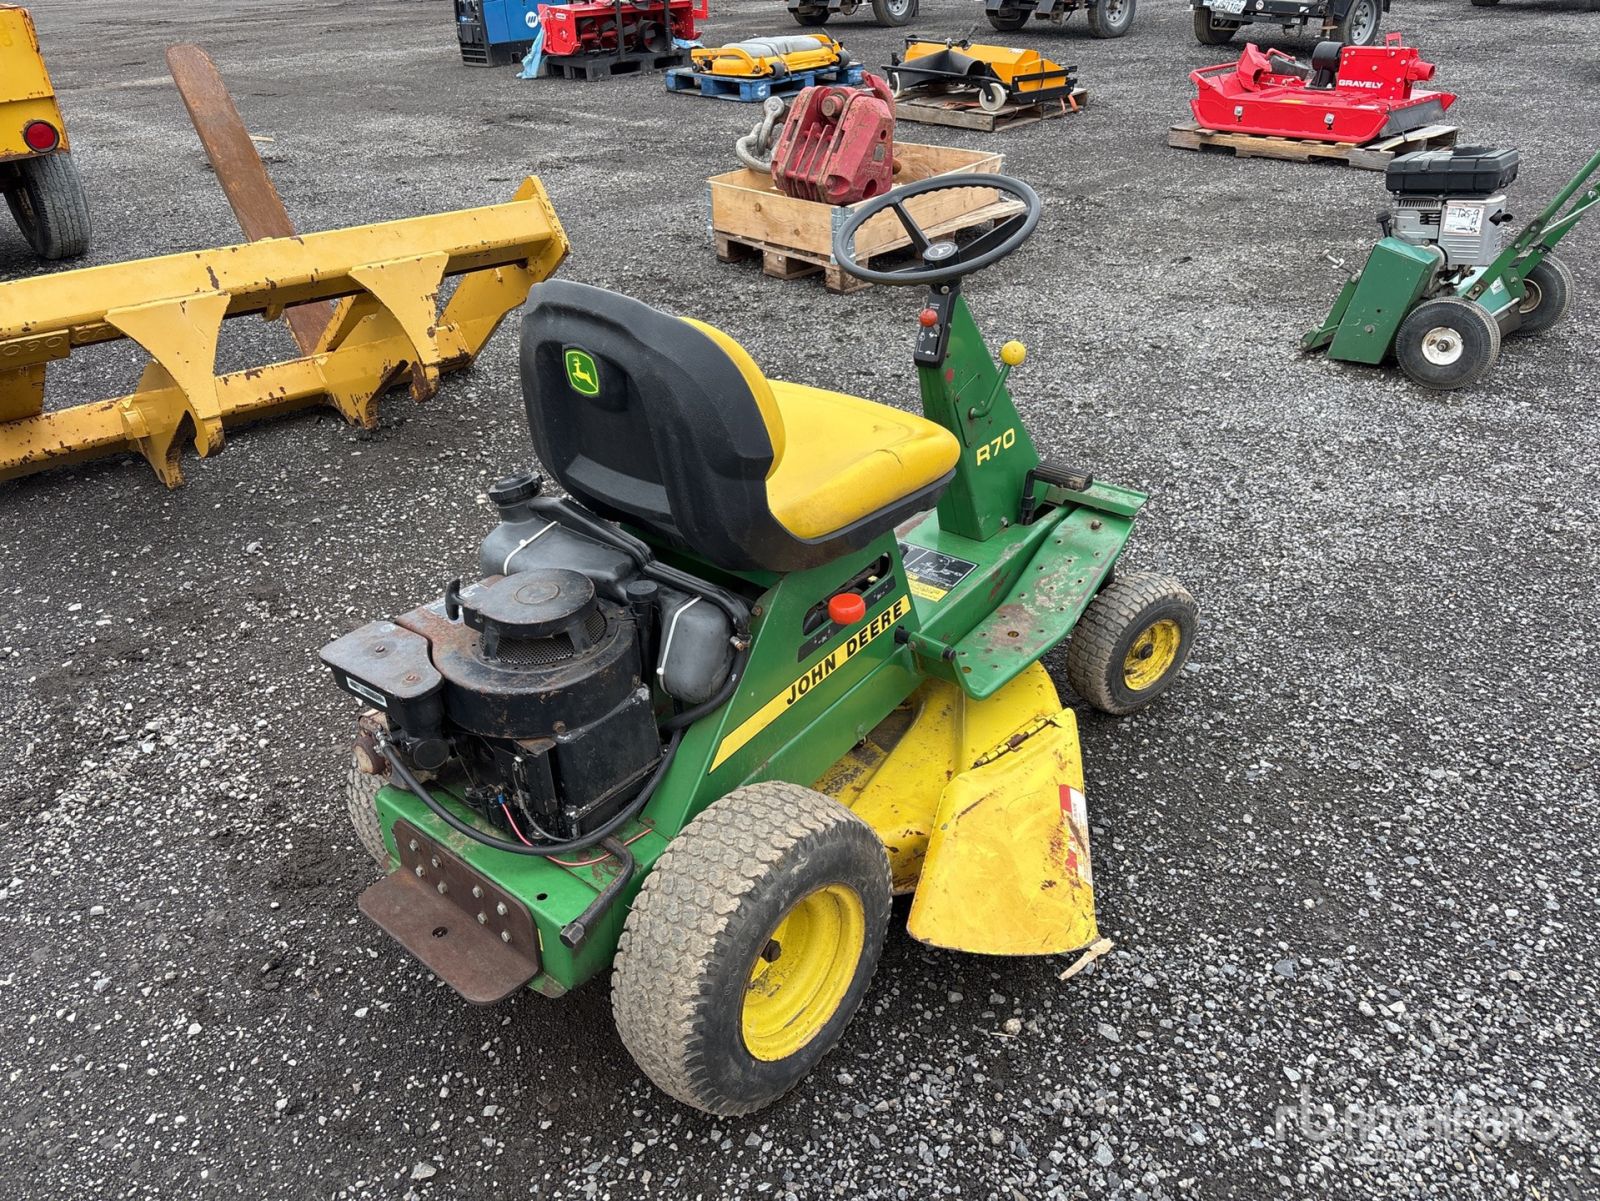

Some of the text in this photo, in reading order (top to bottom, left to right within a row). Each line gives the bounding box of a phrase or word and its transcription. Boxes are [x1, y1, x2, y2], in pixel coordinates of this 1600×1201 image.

[1338, 79, 1383, 89] GRAVELY
[976, 427, 1015, 467] R70
[786, 600, 903, 705] JOHN DEERE
